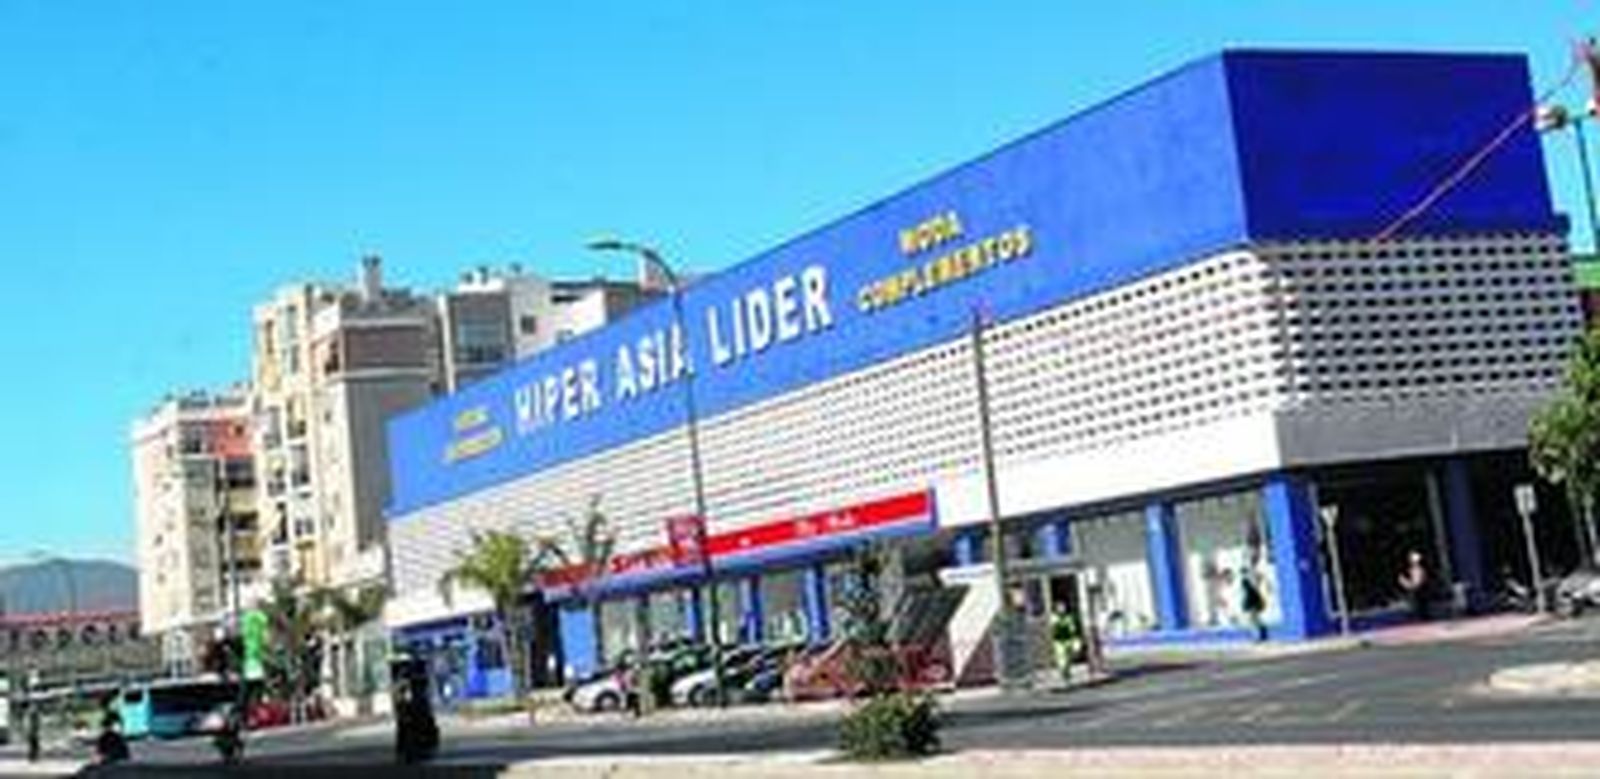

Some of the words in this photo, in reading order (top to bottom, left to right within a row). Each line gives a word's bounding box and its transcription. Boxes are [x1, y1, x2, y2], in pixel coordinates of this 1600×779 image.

[858, 226, 1033, 312] COMPLEMENTOS
[900, 211, 963, 255] MODA
[514, 363, 602, 433] HIPER
[617, 322, 694, 399] ASIA
[707, 266, 833, 366] LIDER
